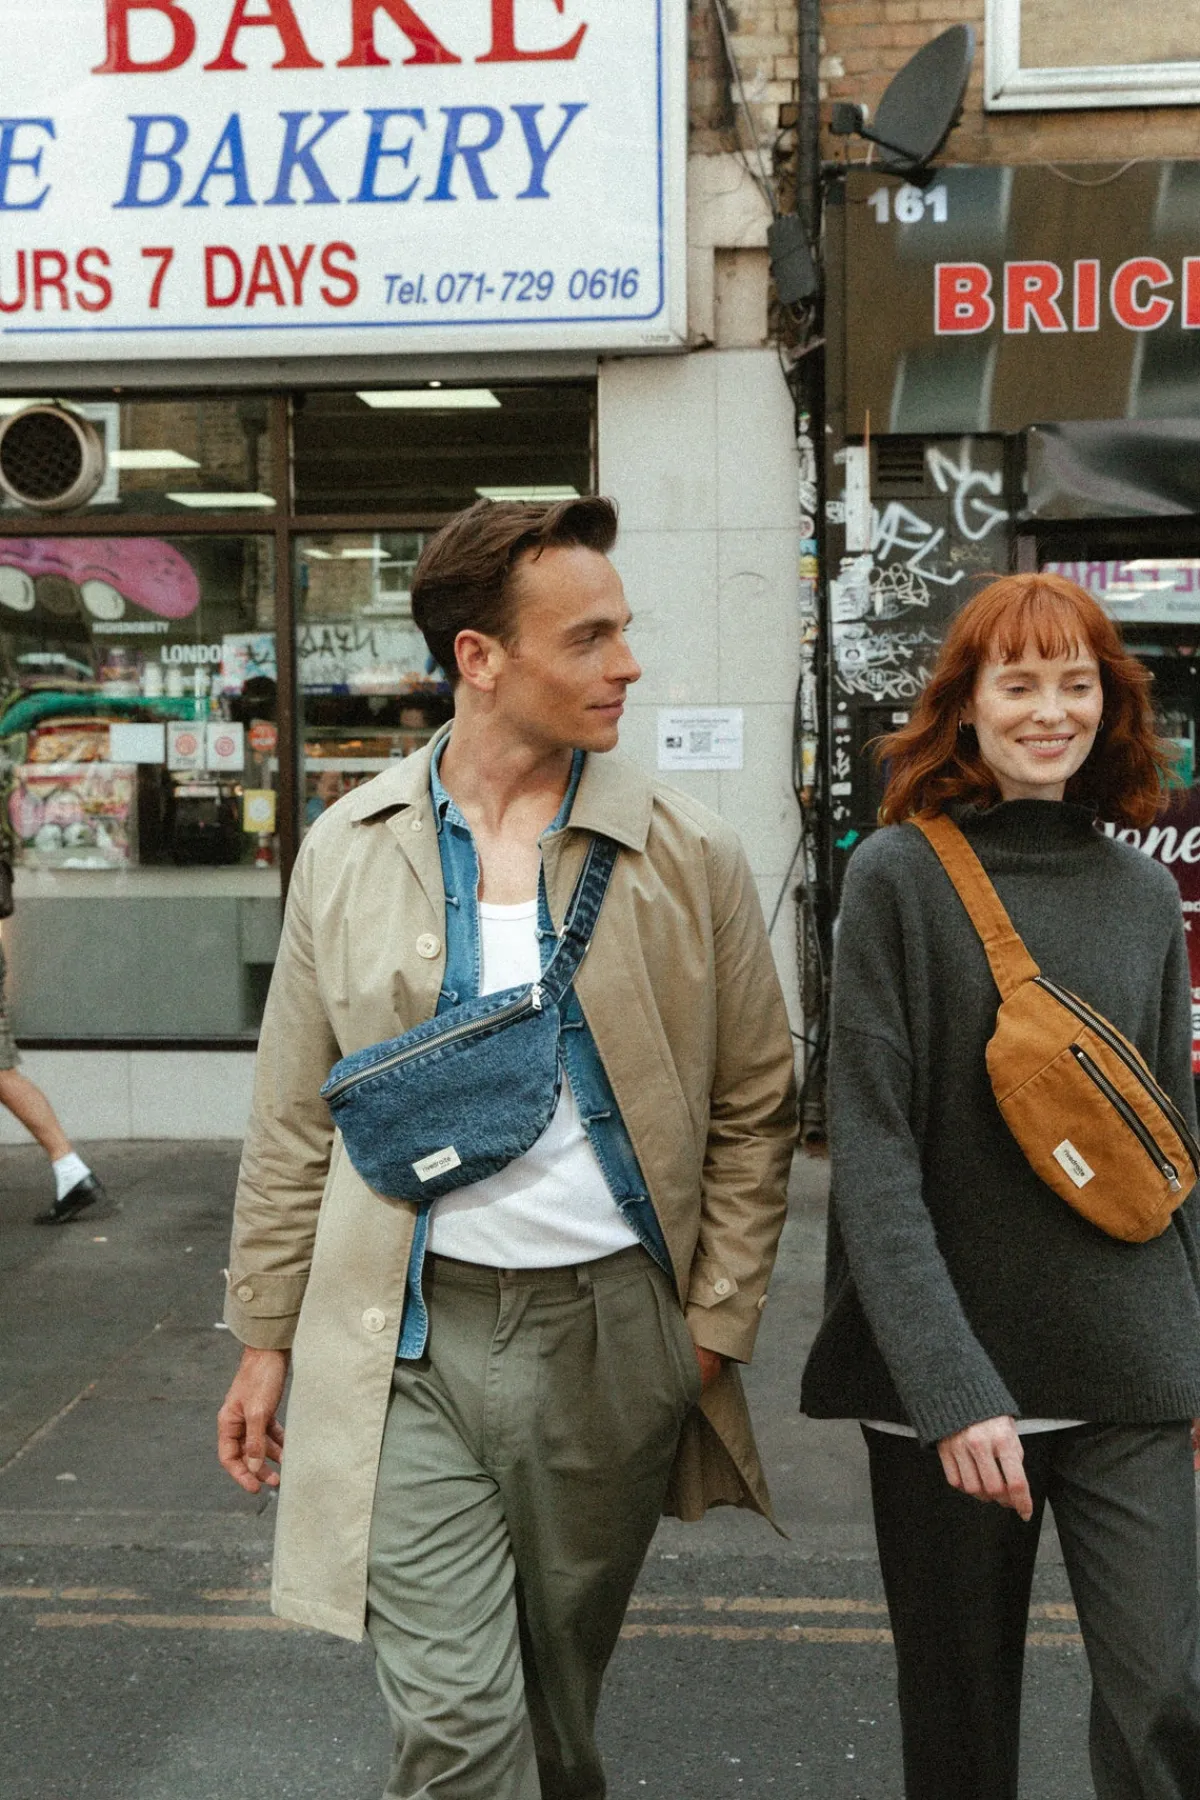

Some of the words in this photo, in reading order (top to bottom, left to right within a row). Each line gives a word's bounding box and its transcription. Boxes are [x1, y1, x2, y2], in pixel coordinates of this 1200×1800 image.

[92, 0, 588, 75] BAKE
[113, 101, 589, 209] BAKERY
[867, 182, 948, 224] 161
[141, 247, 174, 309] 7
[204, 241, 359, 308] DAYS
[384, 273, 427, 305] Tel.
[436, 269, 555, 304] 071-729
[568, 267, 640, 301] 0616
[934, 255, 1200, 336] BRIC
